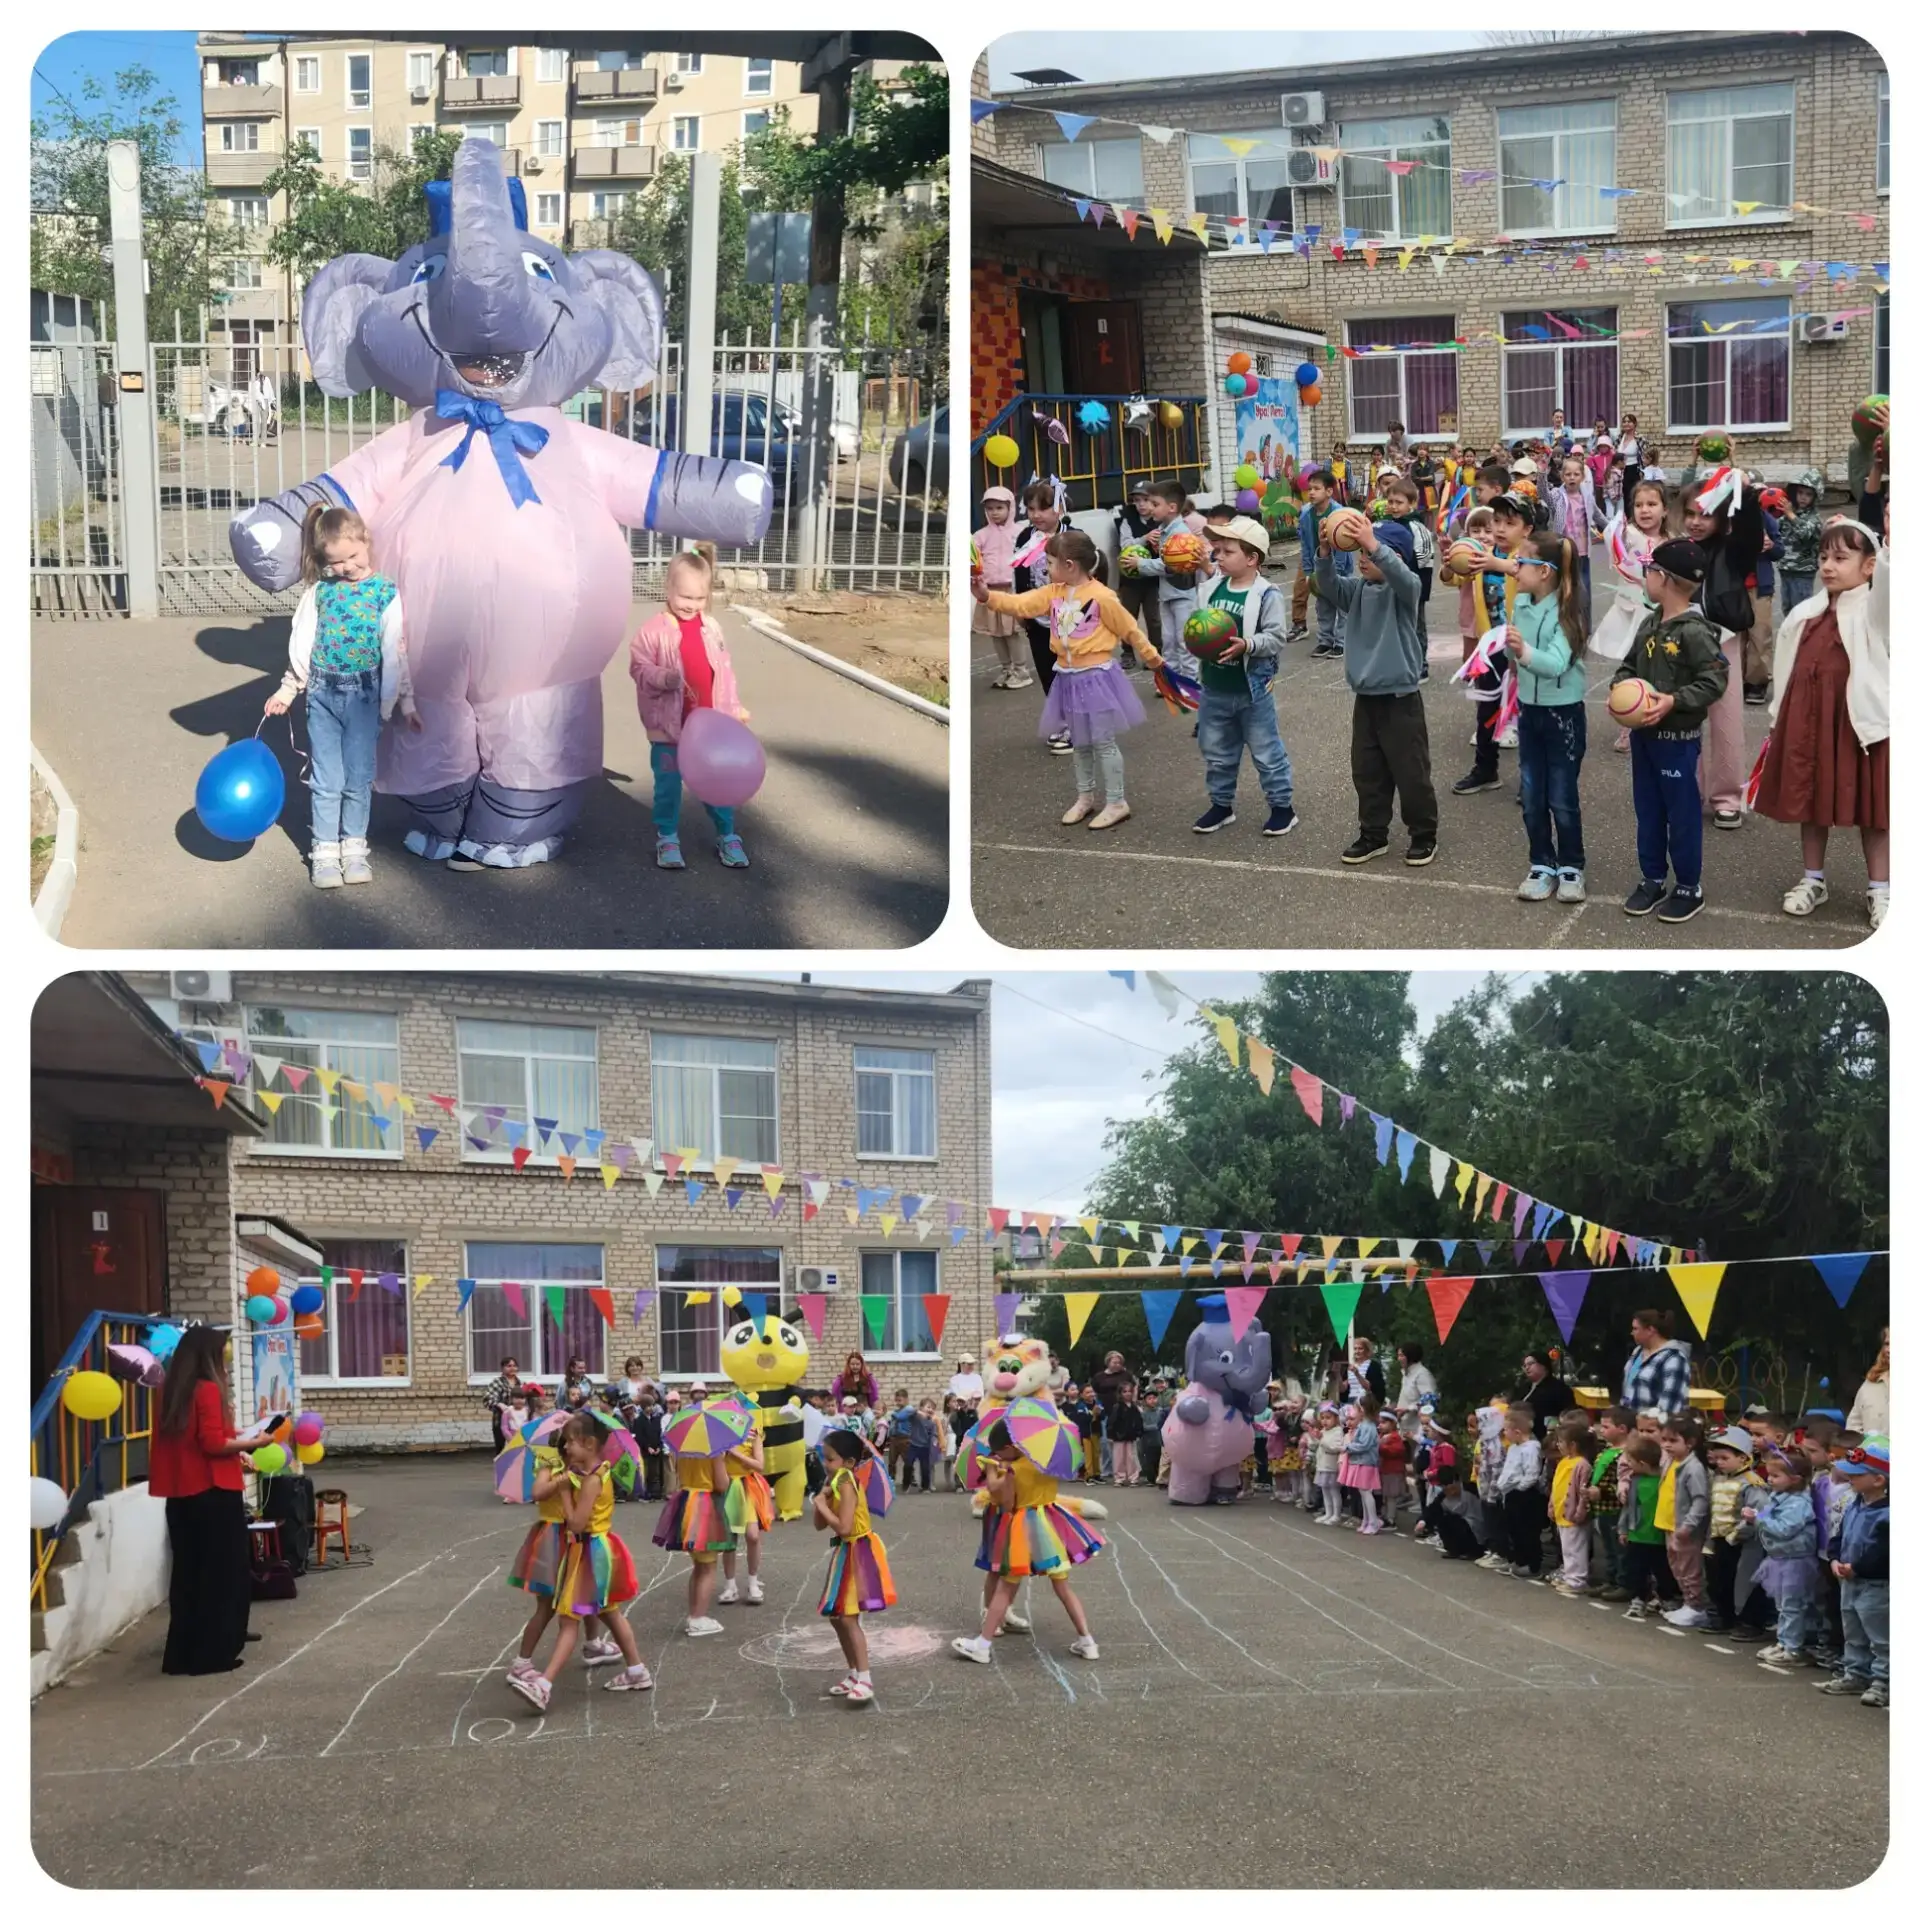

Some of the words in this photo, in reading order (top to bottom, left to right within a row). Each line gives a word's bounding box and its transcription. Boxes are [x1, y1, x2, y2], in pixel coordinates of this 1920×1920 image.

[1255, 403, 1270, 420] Ура!
[1270, 404, 1287, 418] Лето!
[1661, 769, 1682, 777] FILA
